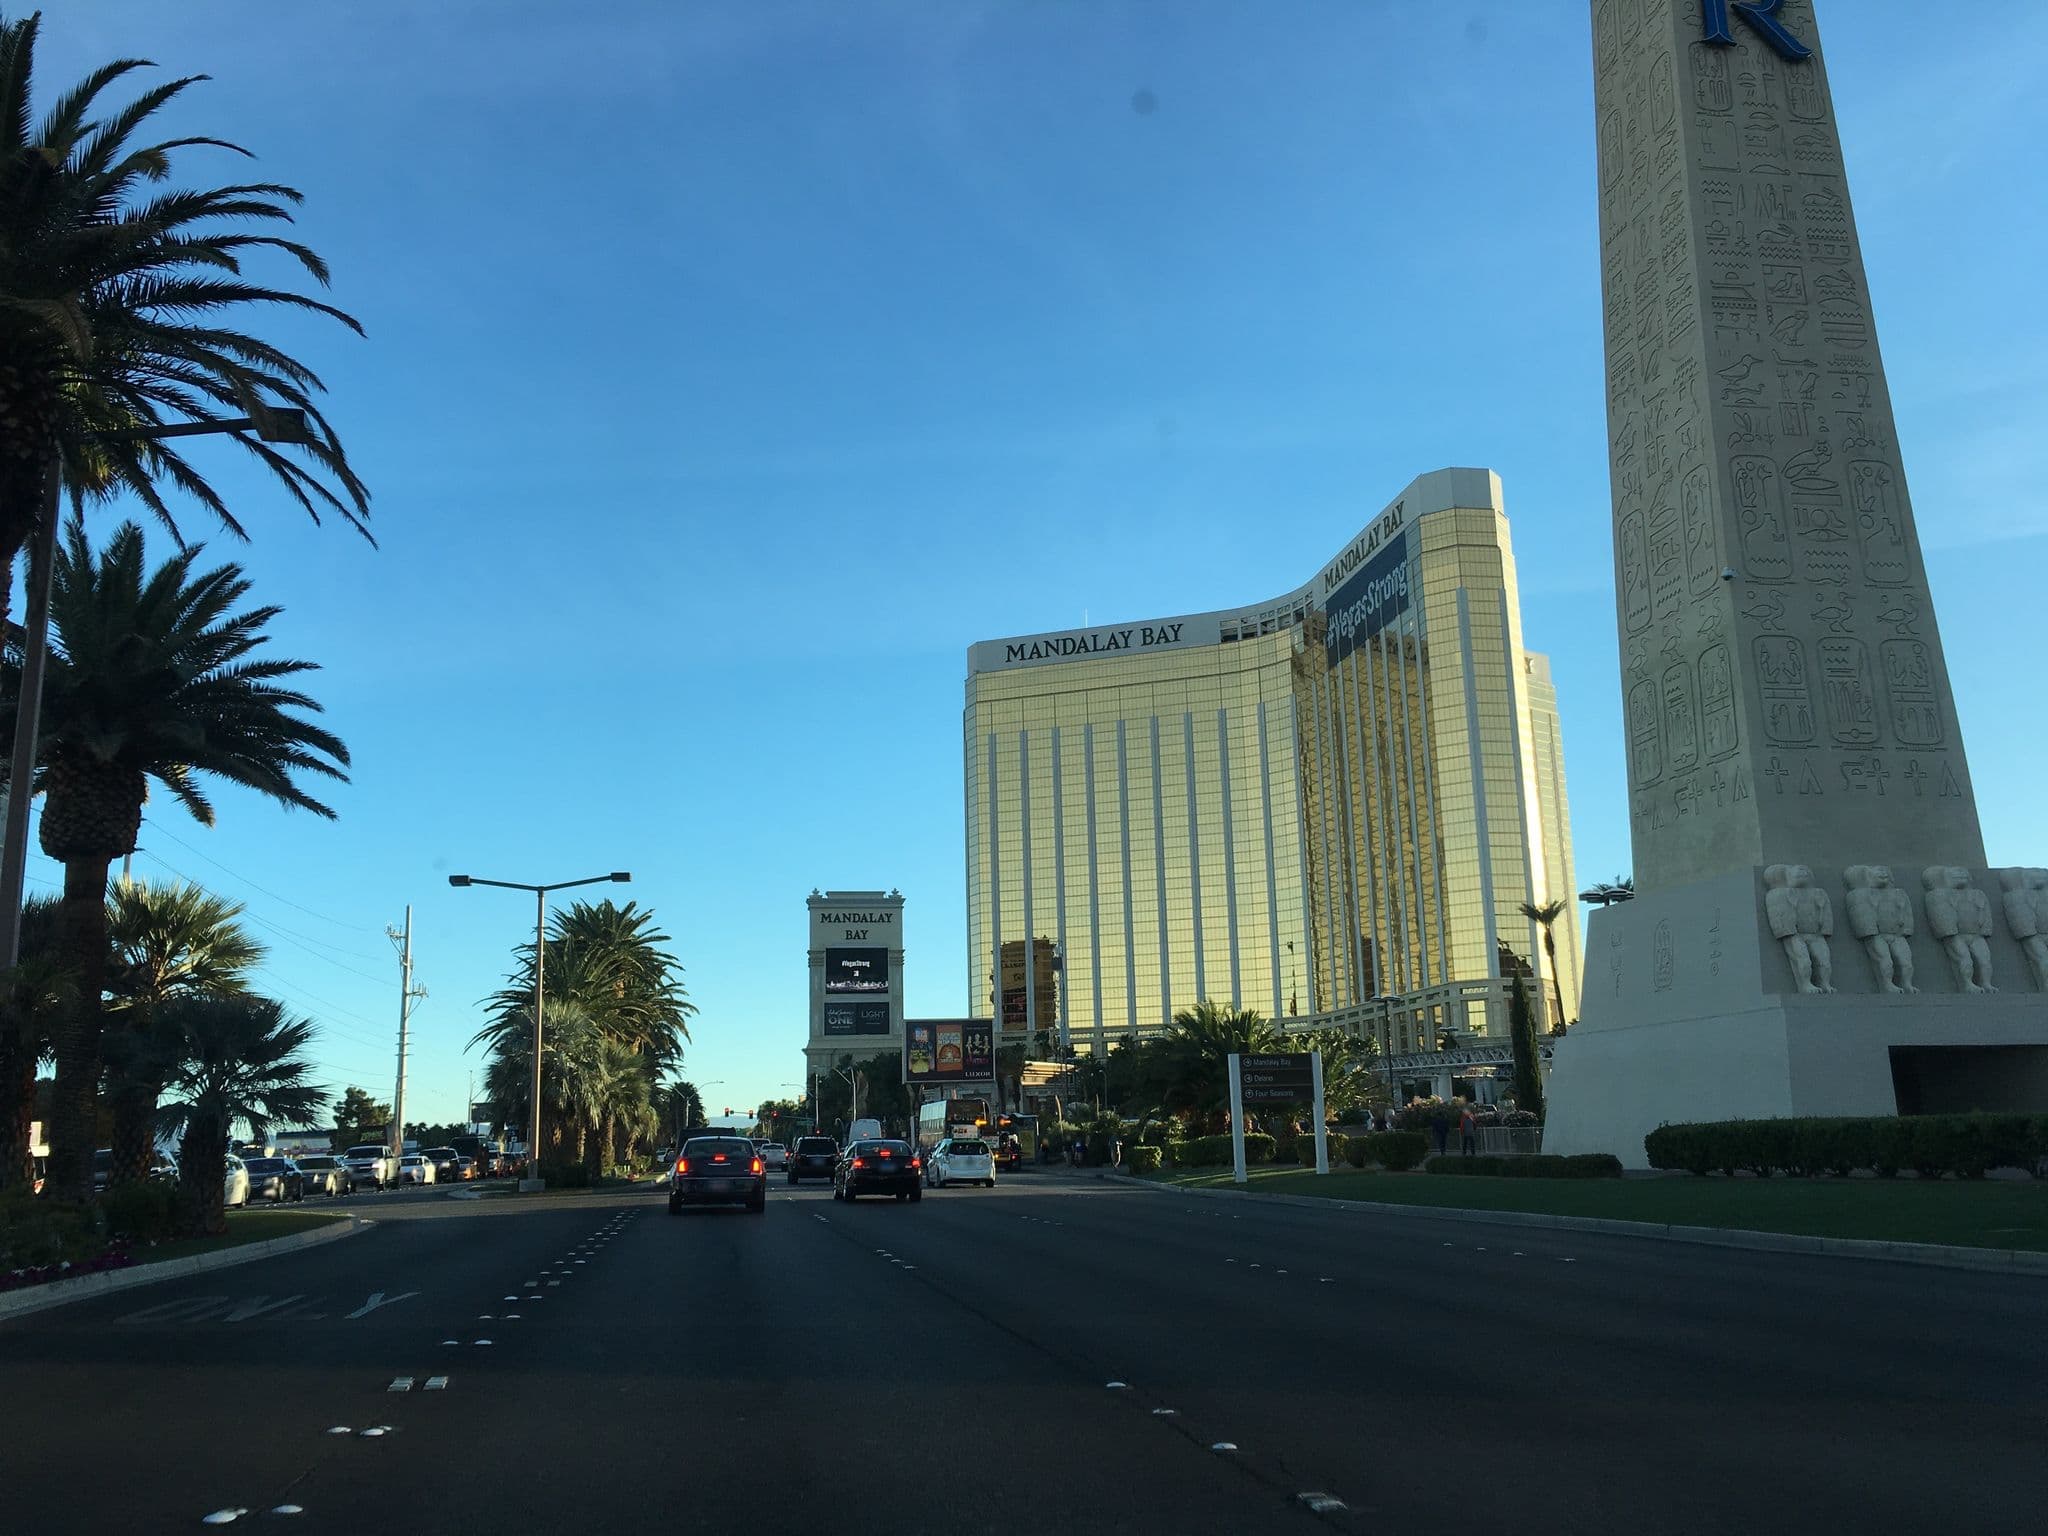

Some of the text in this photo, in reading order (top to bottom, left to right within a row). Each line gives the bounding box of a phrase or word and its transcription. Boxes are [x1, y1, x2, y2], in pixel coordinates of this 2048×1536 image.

[1324, 501, 1405, 594] MANDALAY BAY
[1327, 560, 1407, 648] #VegasStrong
[1005, 623, 1185, 663] MANDALAY BAY
[820, 912, 893, 924] MANDALAY
[845, 929, 869, 941] BAY
[828, 1016, 854, 1025] ONE
[1253, 1058, 1291, 1067] Mandalay Bay
